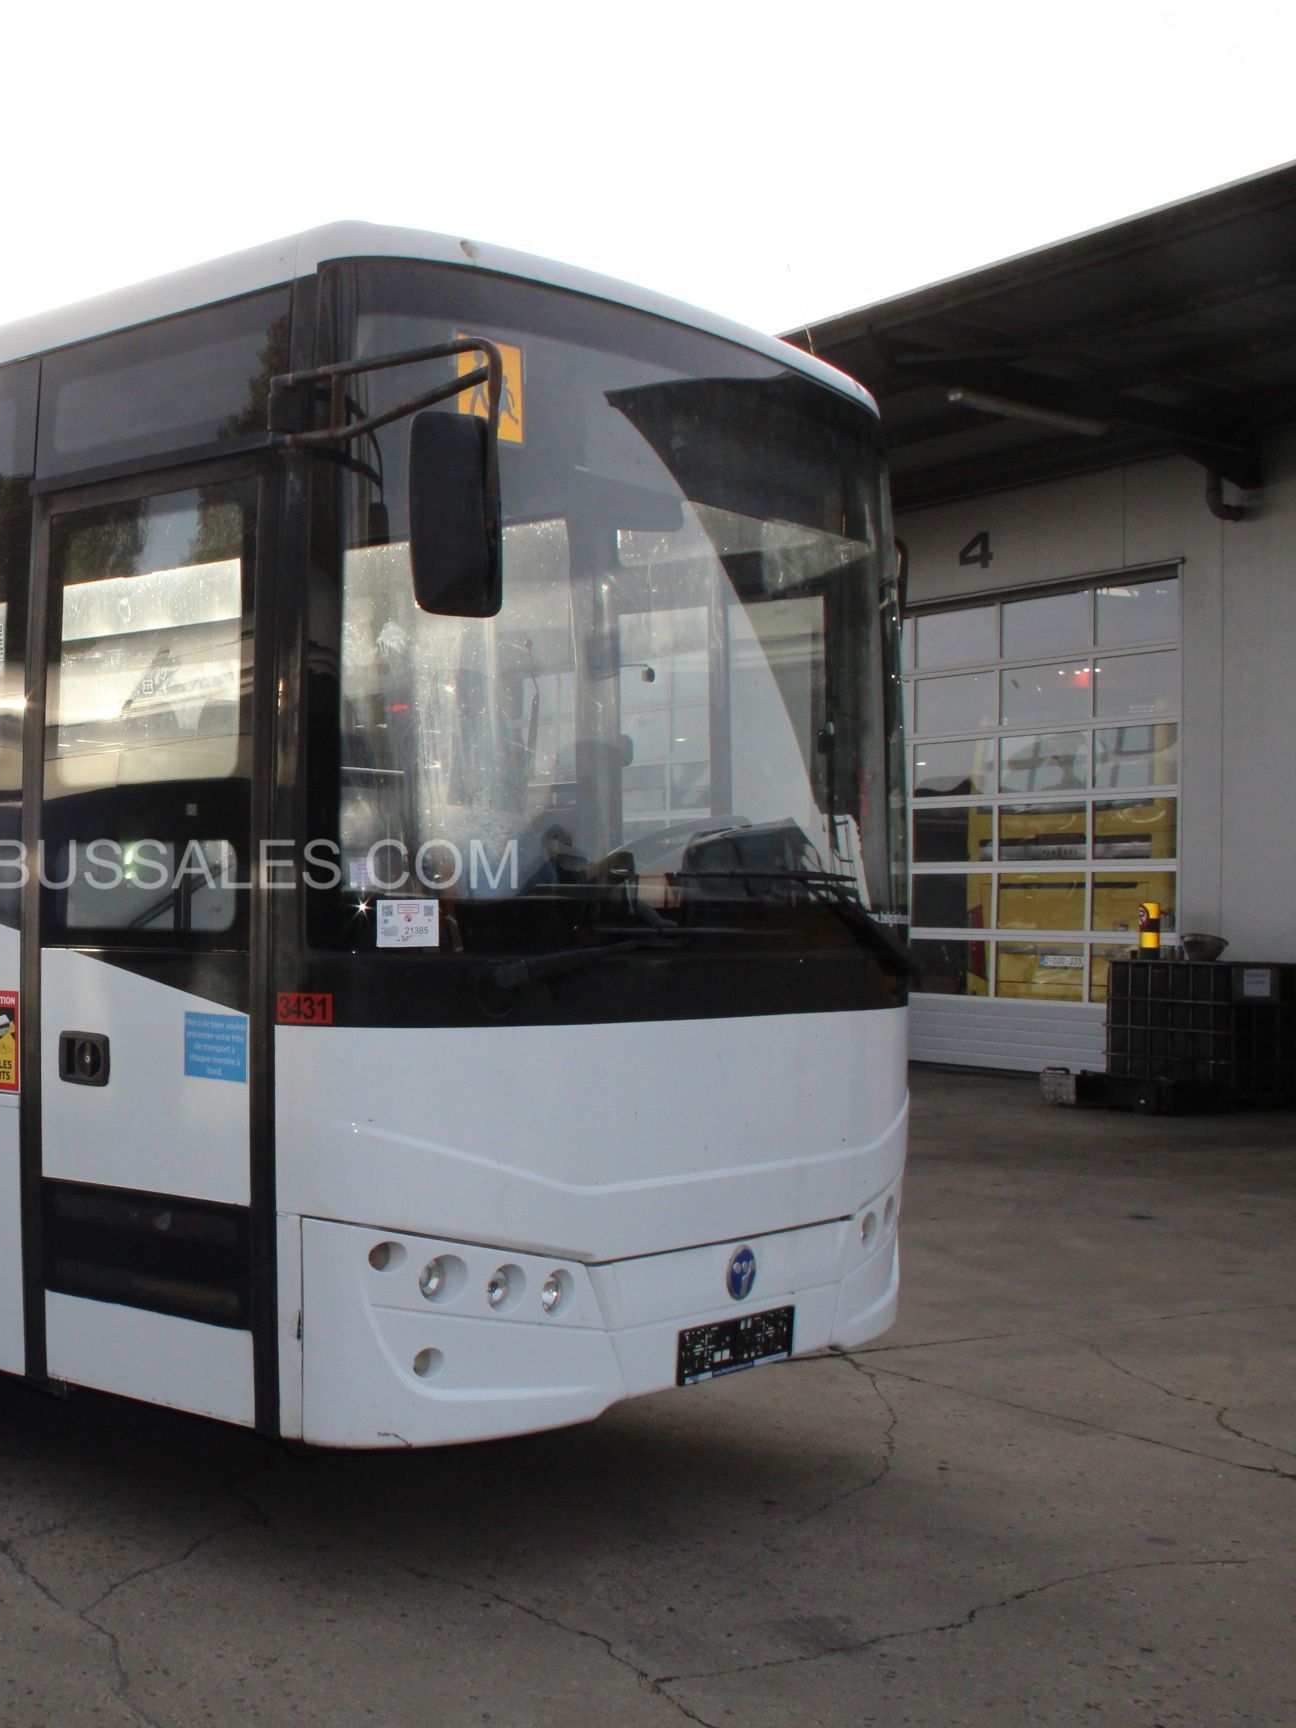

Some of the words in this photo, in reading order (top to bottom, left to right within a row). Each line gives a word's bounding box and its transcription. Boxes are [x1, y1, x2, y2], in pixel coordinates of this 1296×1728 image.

[959, 531, 994, 569] 4
[404, 926, 429, 935] 21385
[279, 995, 327, 1020] 3431
